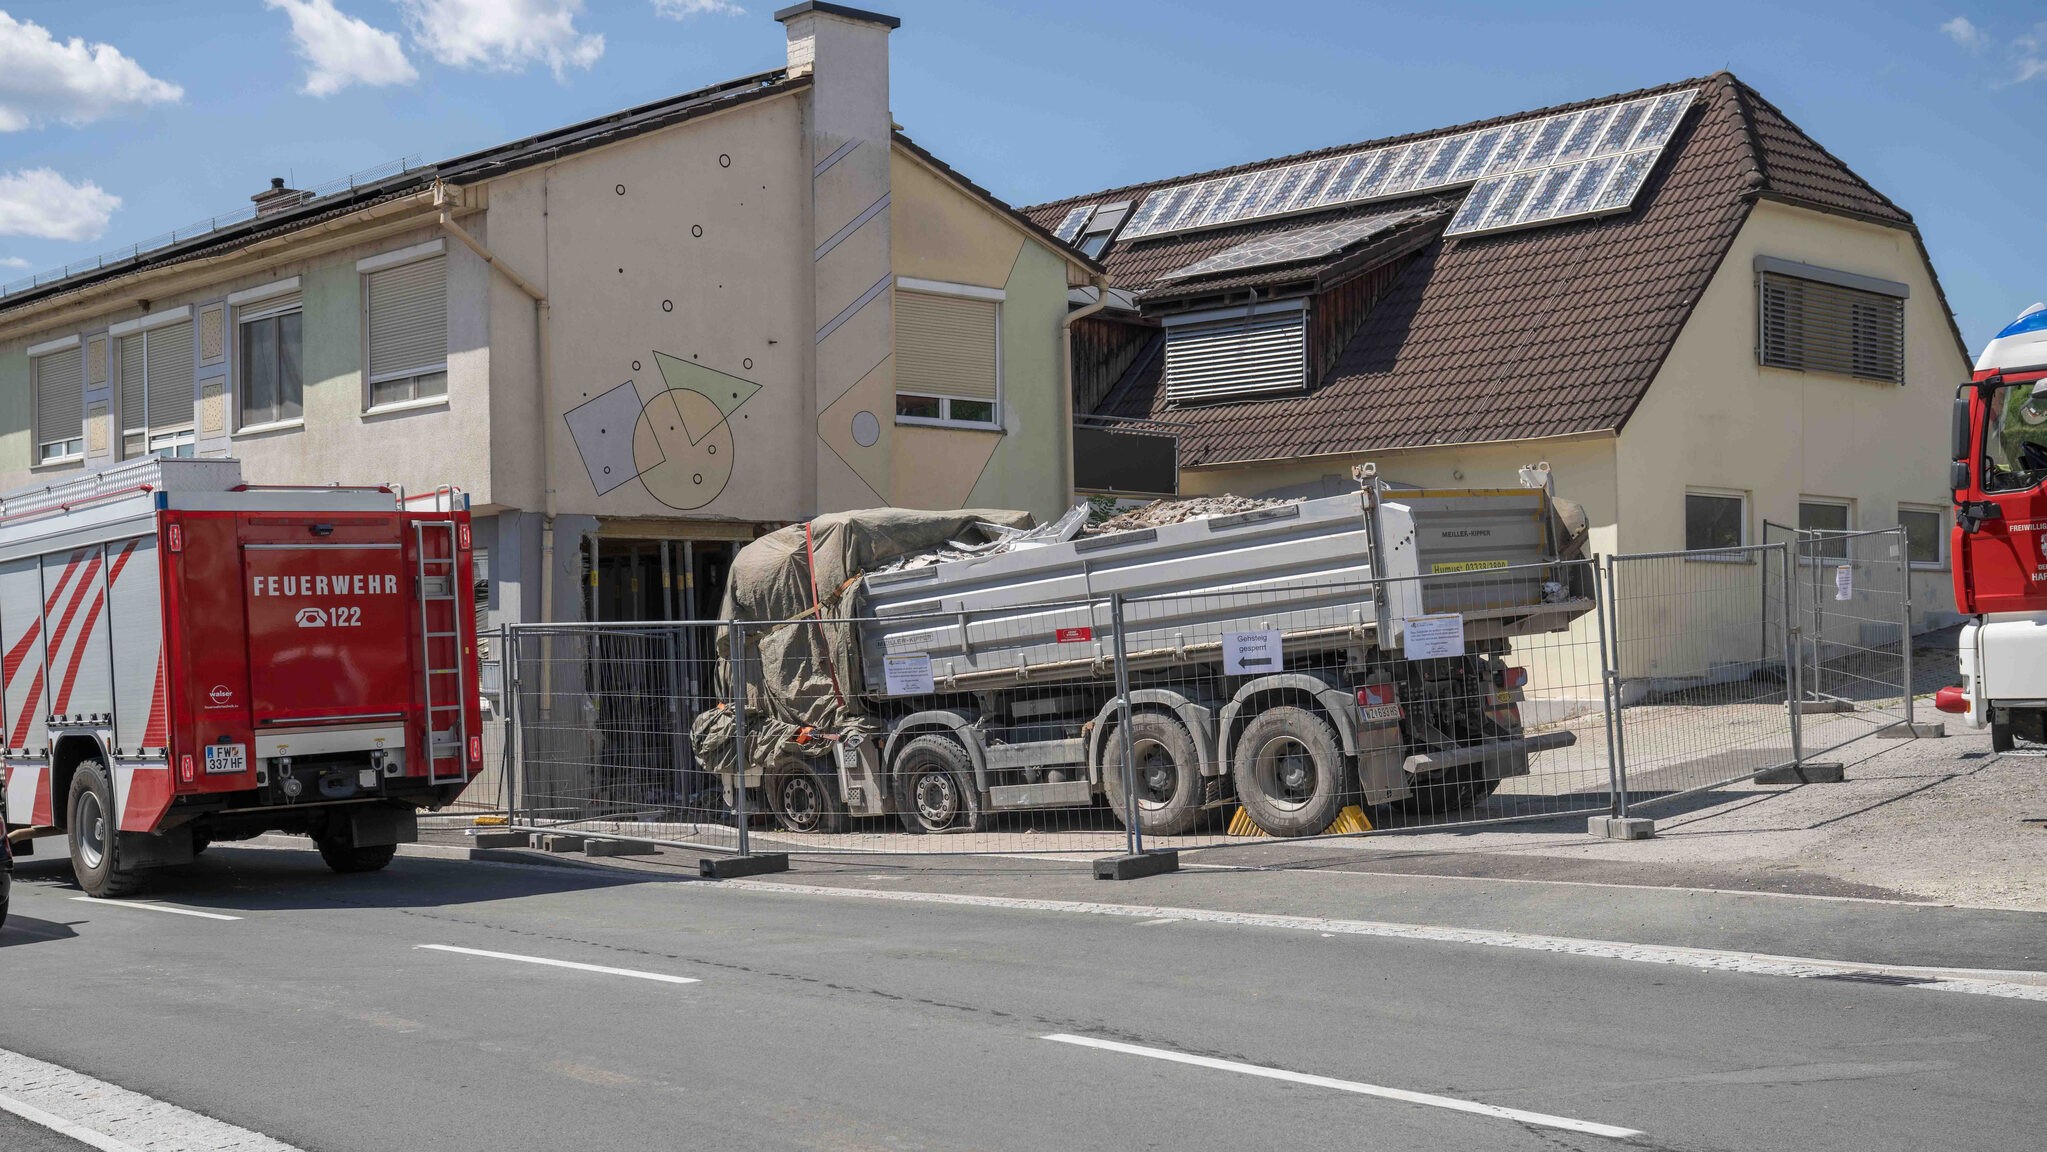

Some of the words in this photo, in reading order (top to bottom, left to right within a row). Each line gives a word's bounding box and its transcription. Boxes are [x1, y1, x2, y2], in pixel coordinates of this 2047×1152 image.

[253, 574, 398, 597] FEUERWEHR
[329, 606, 362, 627] 122
[1239, 645, 1267, 653] gesperrt
[209, 690, 233, 698] walser
[217, 746, 232, 758] FW
[209, 758, 229, 770] 337
[230, 757, 243, 769] HF
